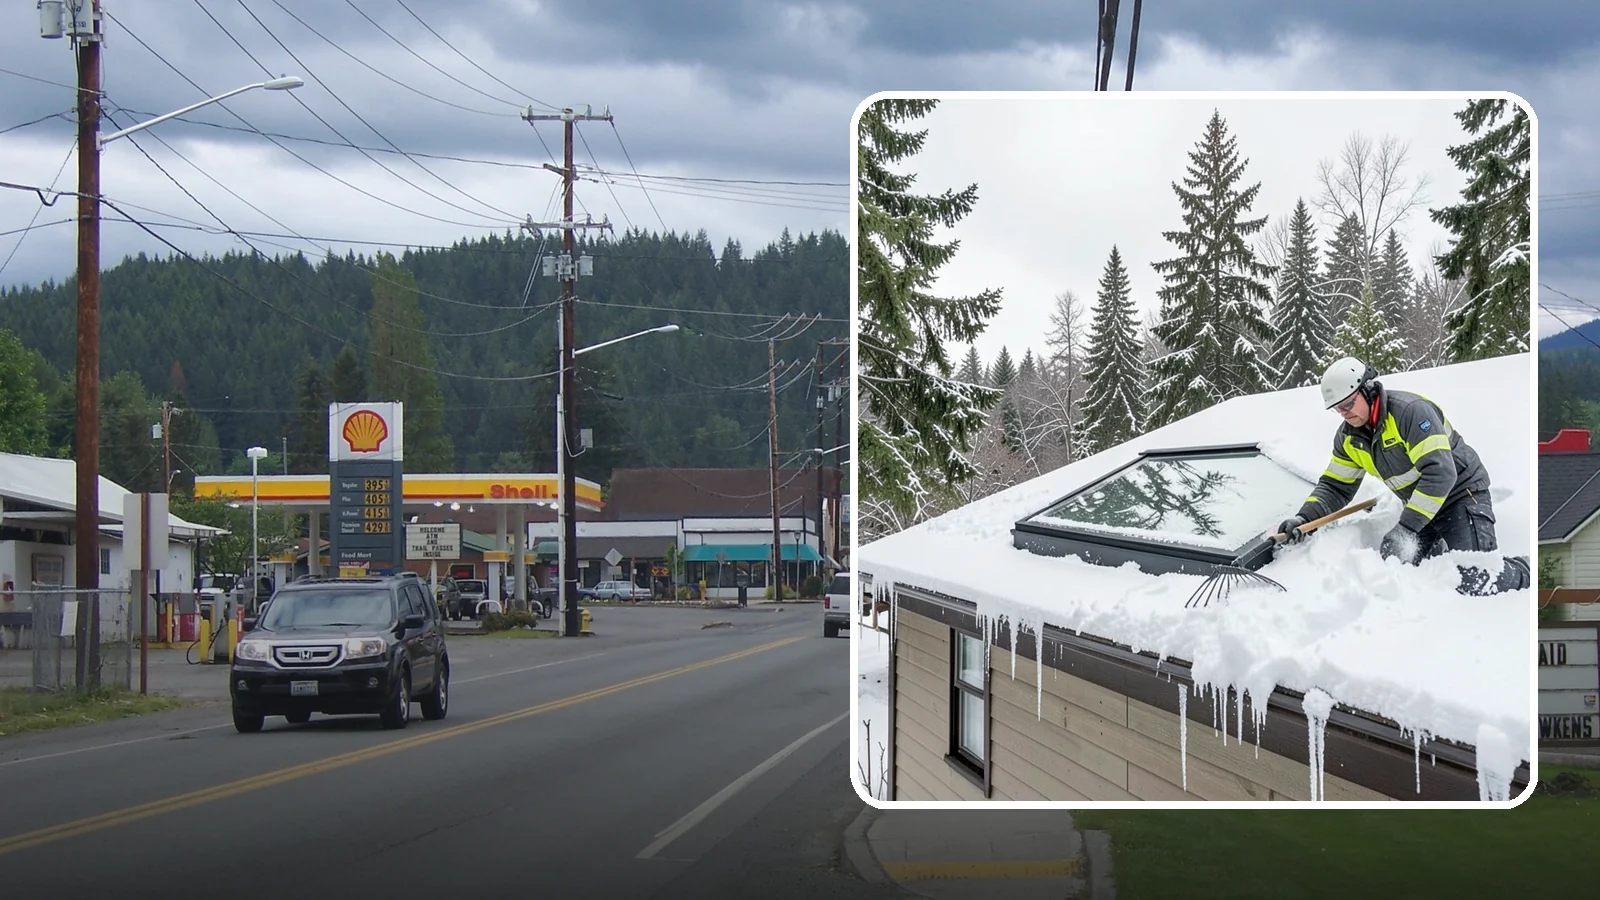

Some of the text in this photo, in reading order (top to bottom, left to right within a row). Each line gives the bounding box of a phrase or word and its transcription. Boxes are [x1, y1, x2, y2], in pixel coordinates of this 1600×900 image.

[366, 480, 384, 490] 395
[490, 484, 547, 499] Shell
[365, 494, 384, 504] 405
[365, 508, 383, 518] 415
[366, 522, 384, 532] 429
